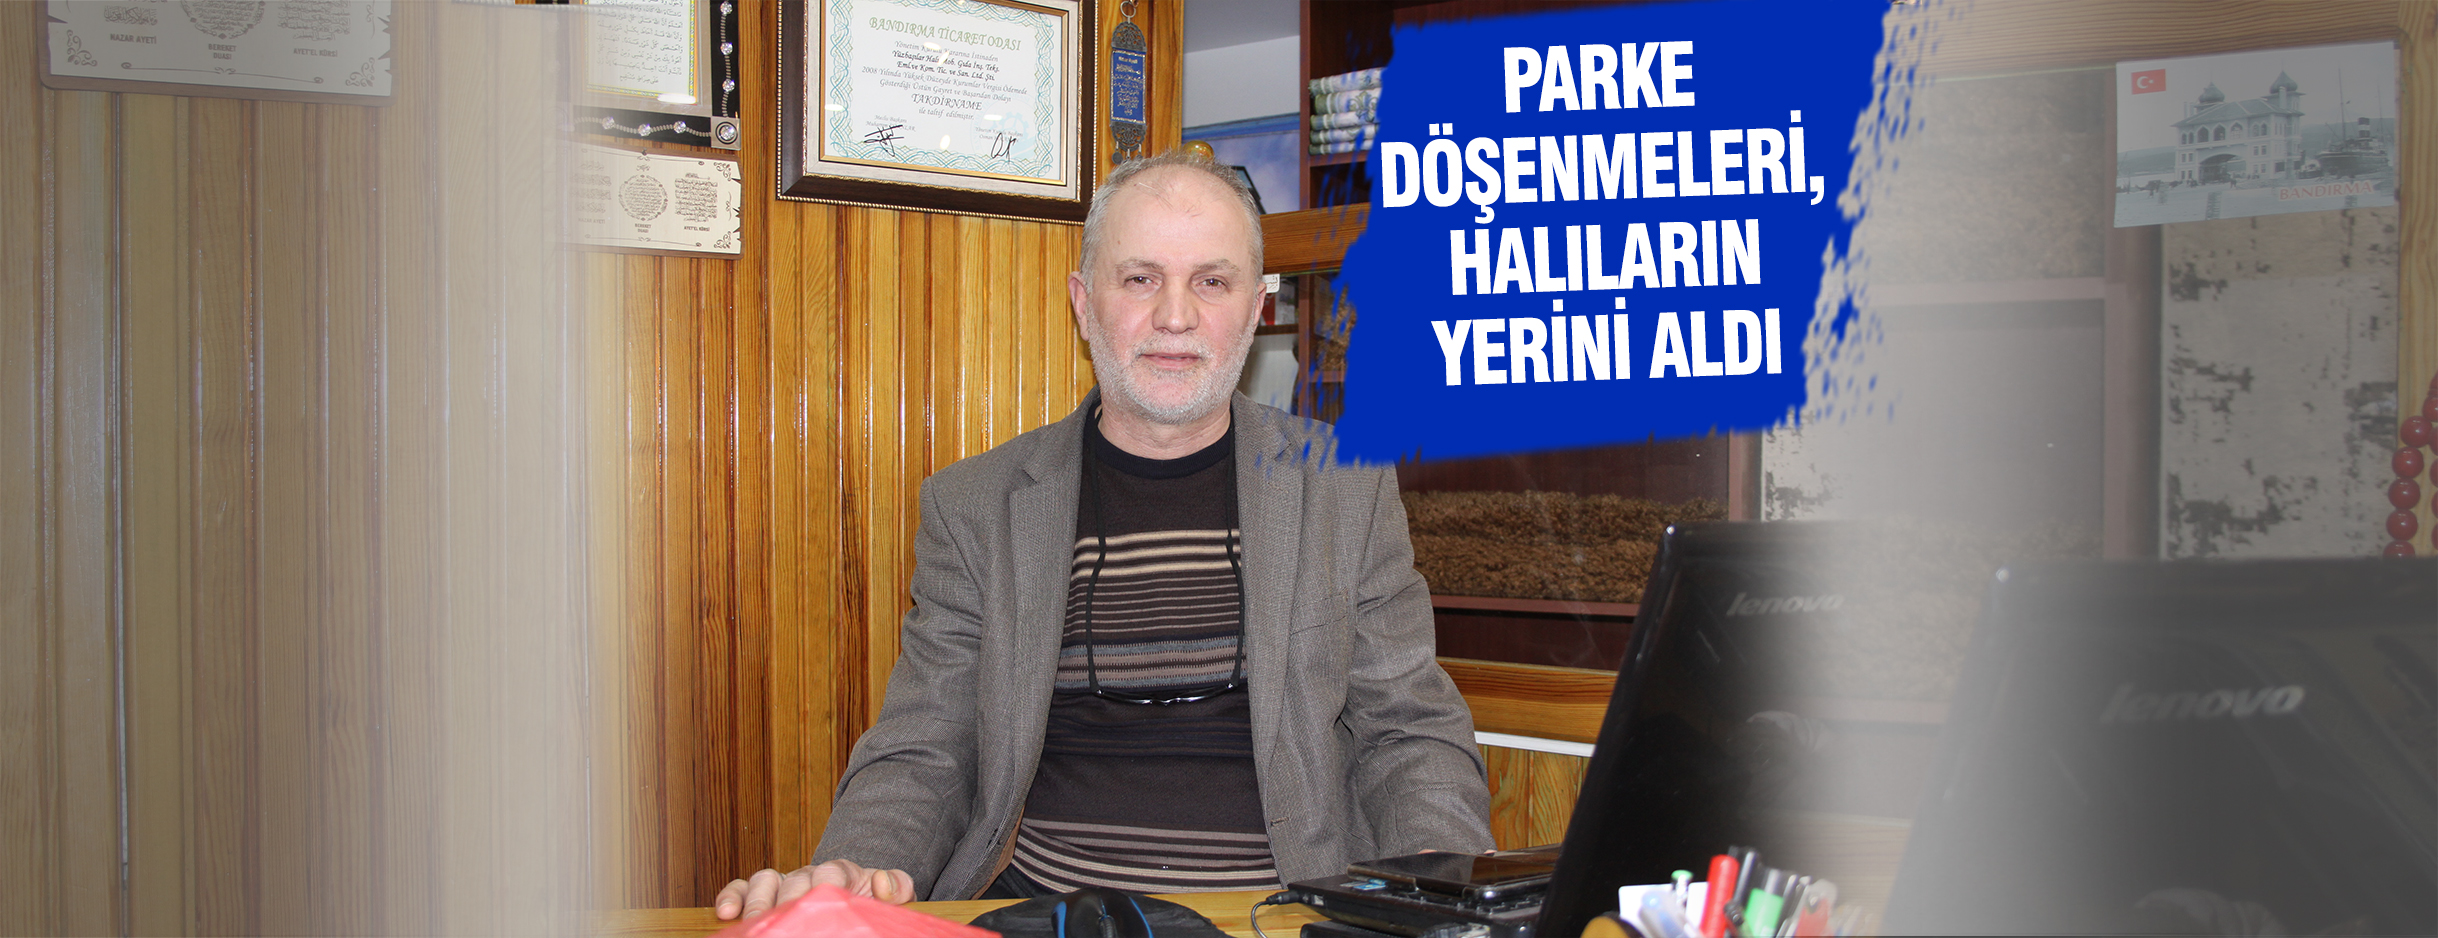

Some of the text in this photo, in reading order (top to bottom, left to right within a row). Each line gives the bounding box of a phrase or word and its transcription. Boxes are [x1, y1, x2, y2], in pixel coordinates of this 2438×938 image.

[110, 33, 157, 44] NAZAR AYETİ
[869, 16, 1021, 51] BANDIRMA TİCARET ODASI
[208, 43, 237, 52] BEREKET
[895, 41, 919, 51] Yönetim
[212, 52, 231, 60] DUASI
[861, 66, 878, 74] 2008
[903, 71, 925, 82] Yüksek
[926, 75, 951, 85] Düzeyde
[953, 79, 981, 88] Kurumlar
[1002, 84, 1028, 95] Ödemede
[933, 85, 953, 95] Gayret
[911, 93, 982, 110] TAKDİRNAME
[927, 108, 944, 118] taltif
[2279, 181, 2374, 200] BANDIRMA
[1726, 592, 1845, 616] lenovo
[2101, 683, 2305, 725] lenovo
